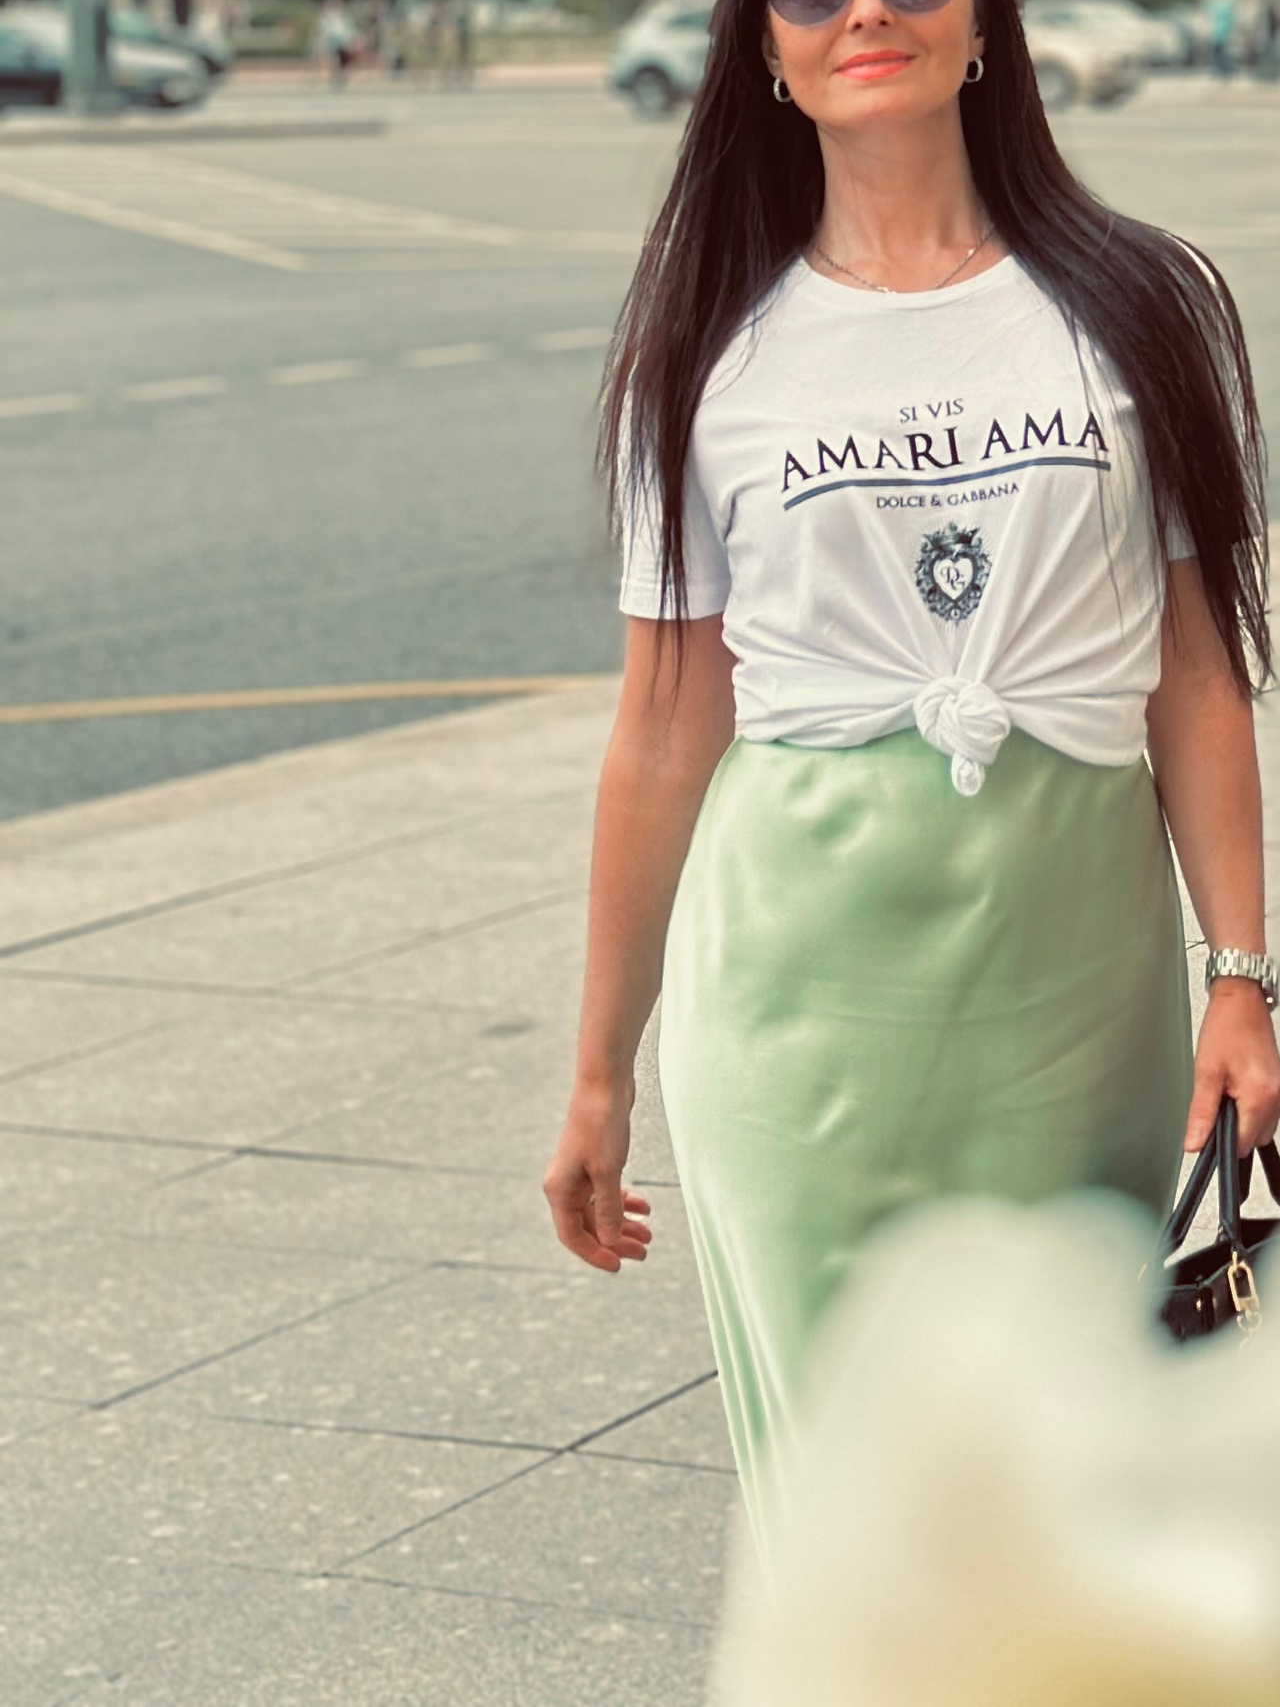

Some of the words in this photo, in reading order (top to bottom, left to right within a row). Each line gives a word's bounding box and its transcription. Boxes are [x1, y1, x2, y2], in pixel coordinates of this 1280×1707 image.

[899, 406, 917, 424] SI
[927, 398, 965, 419] VIS
[781, 426, 964, 493] AMARI
[980, 407, 1110, 462] AMA
[876, 495, 926, 508] DOLCE
[930, 494, 942, 507] &
[946, 482, 1020, 507] GABBANA
